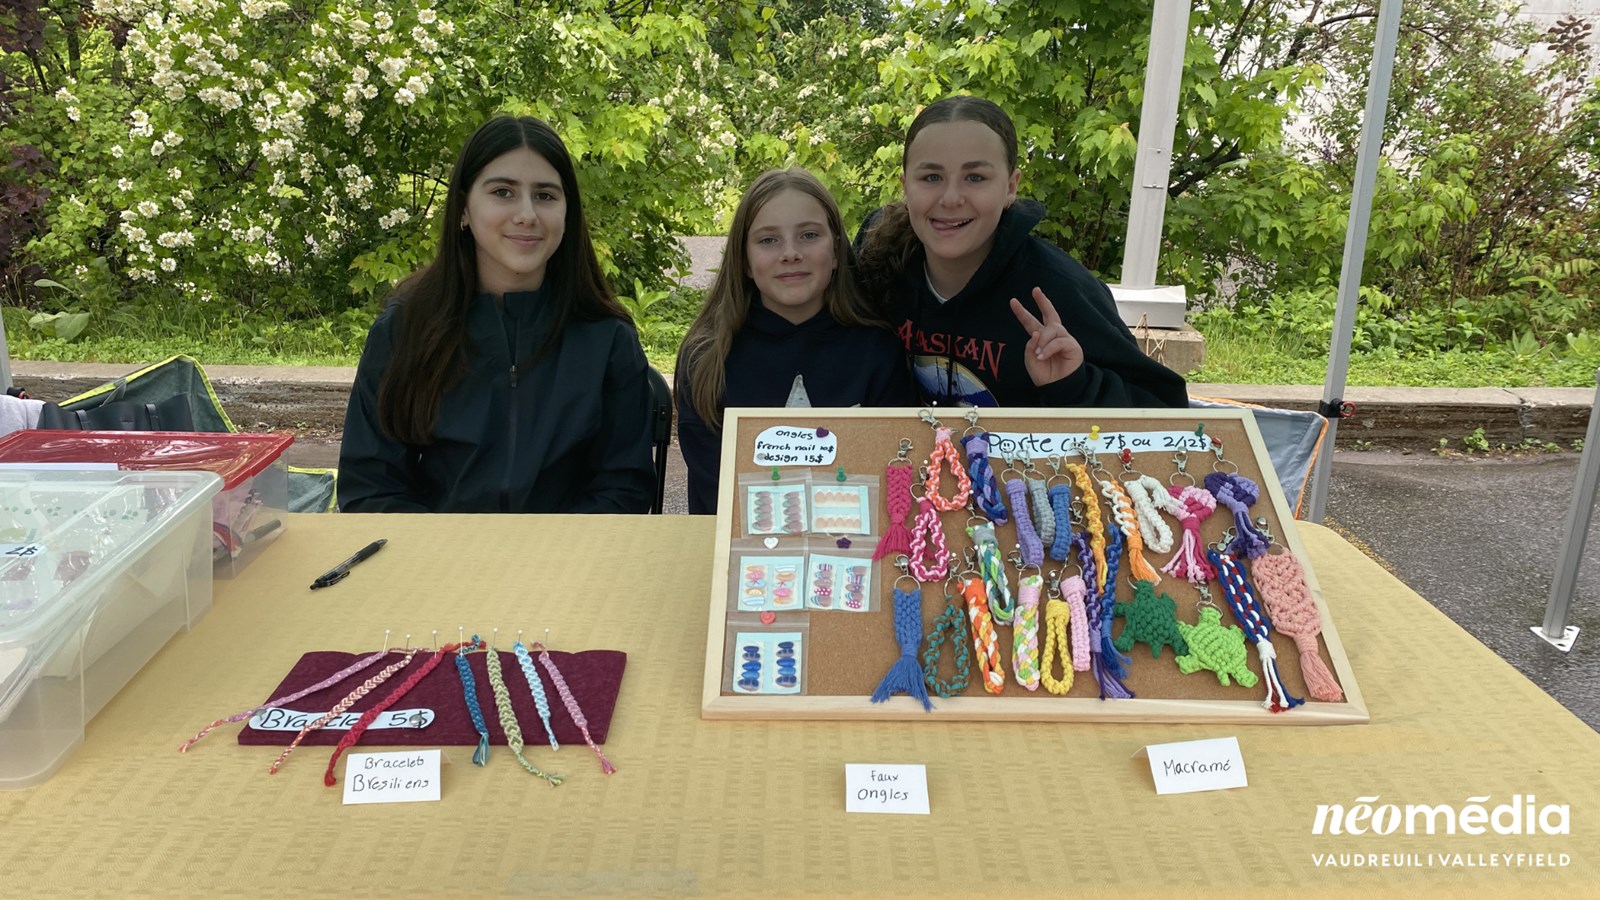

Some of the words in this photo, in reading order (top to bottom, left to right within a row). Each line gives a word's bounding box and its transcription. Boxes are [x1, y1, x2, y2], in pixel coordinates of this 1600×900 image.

[820, 445, 834, 453] 10$
[988, 433, 1053, 454] Porte
[1103, 434, 1126, 450] 7$
[1132, 438, 1151, 448] ou
[1163, 435, 1208, 449] 2/12$
[764, 453, 798, 462] design
[804, 454, 824, 463] 15$
[388, 710, 428, 729] 5$
[1163, 759, 1232, 776] Macramé
